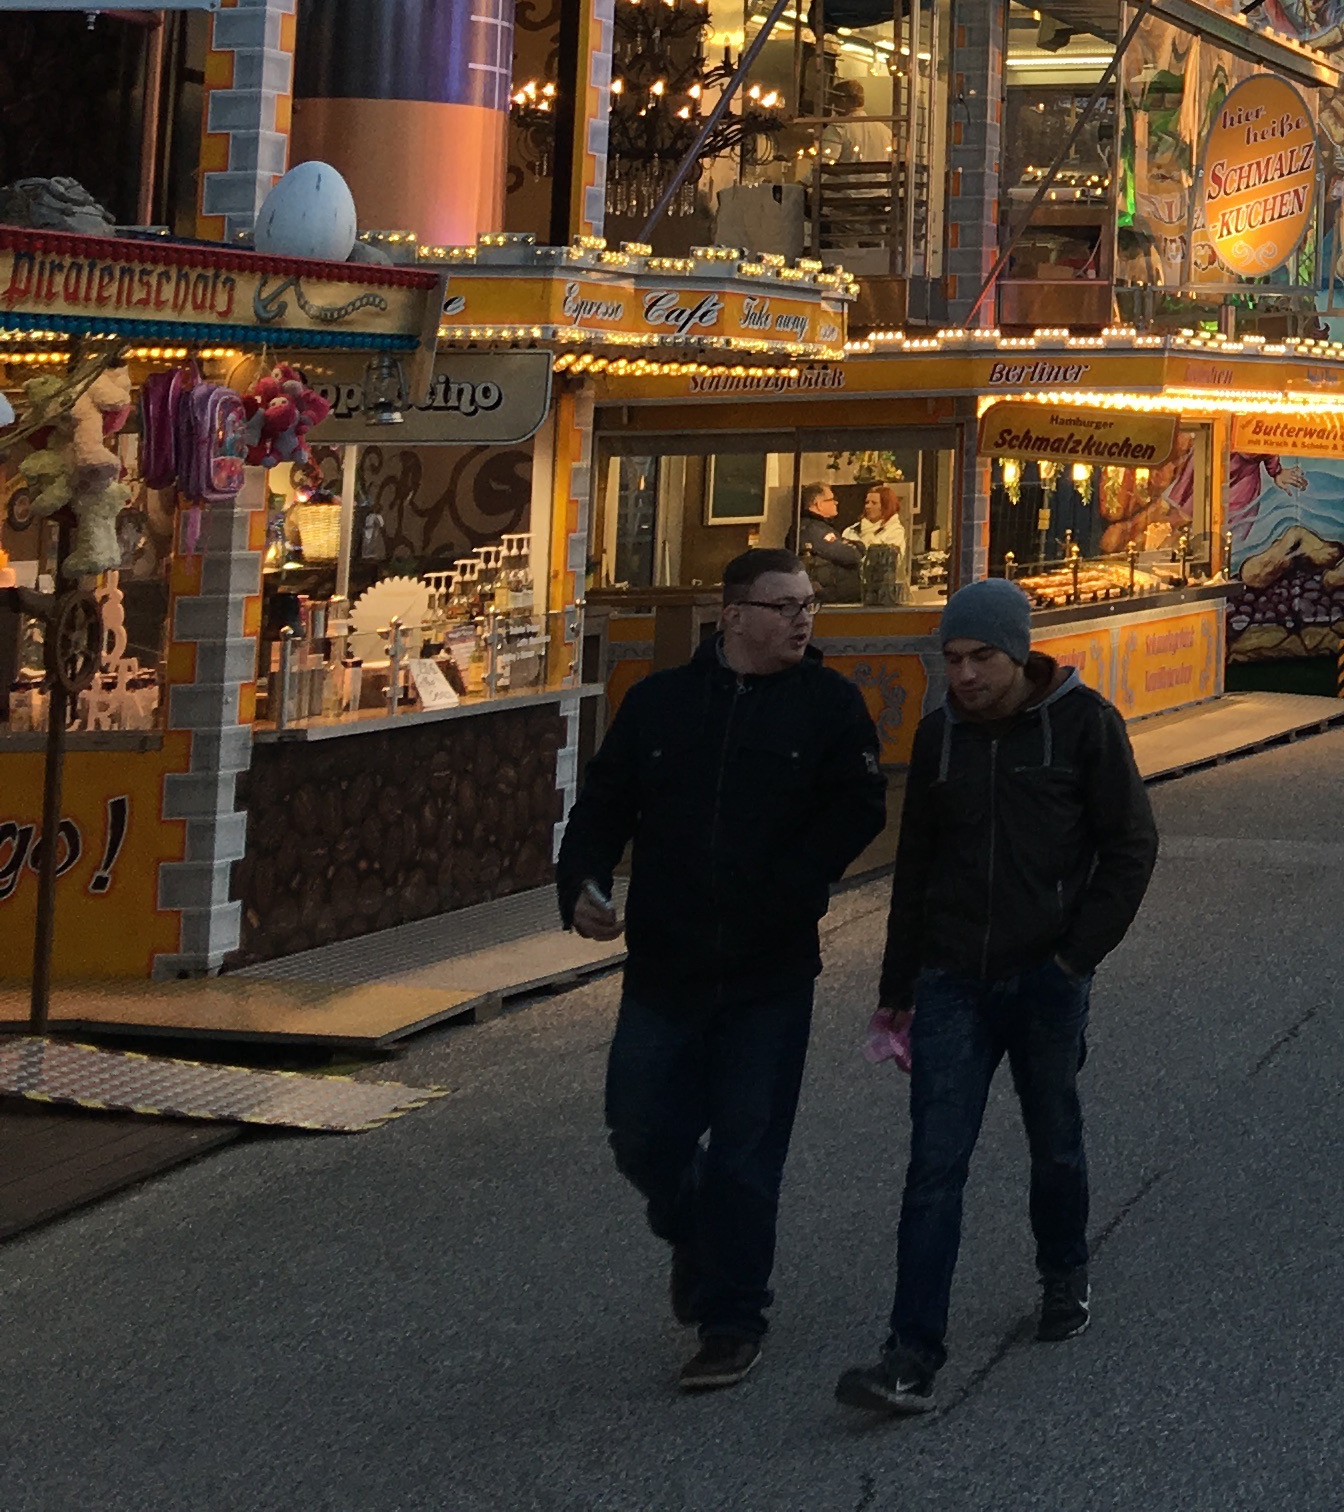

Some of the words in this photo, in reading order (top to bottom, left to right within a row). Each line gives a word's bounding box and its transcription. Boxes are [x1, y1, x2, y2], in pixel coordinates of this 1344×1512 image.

[1222, 105, 1266, 130] hier
[1245, 114, 1306, 146] heiße
[1206, 142, 1317, 202] SCHMALZ
[1211, 184, 1308, 240] -KUCHEN
[562, 282, 624, 326] Espresso
[643, 292, 724, 334] Café
[740, 296, 772, 330] Take
[776, 312, 809, 339] away
[989, 361, 1091, 385] Berliner
[1049, 414, 1115, 430] Hamburger
[993, 428, 1157, 461] Schmalzkuchen
